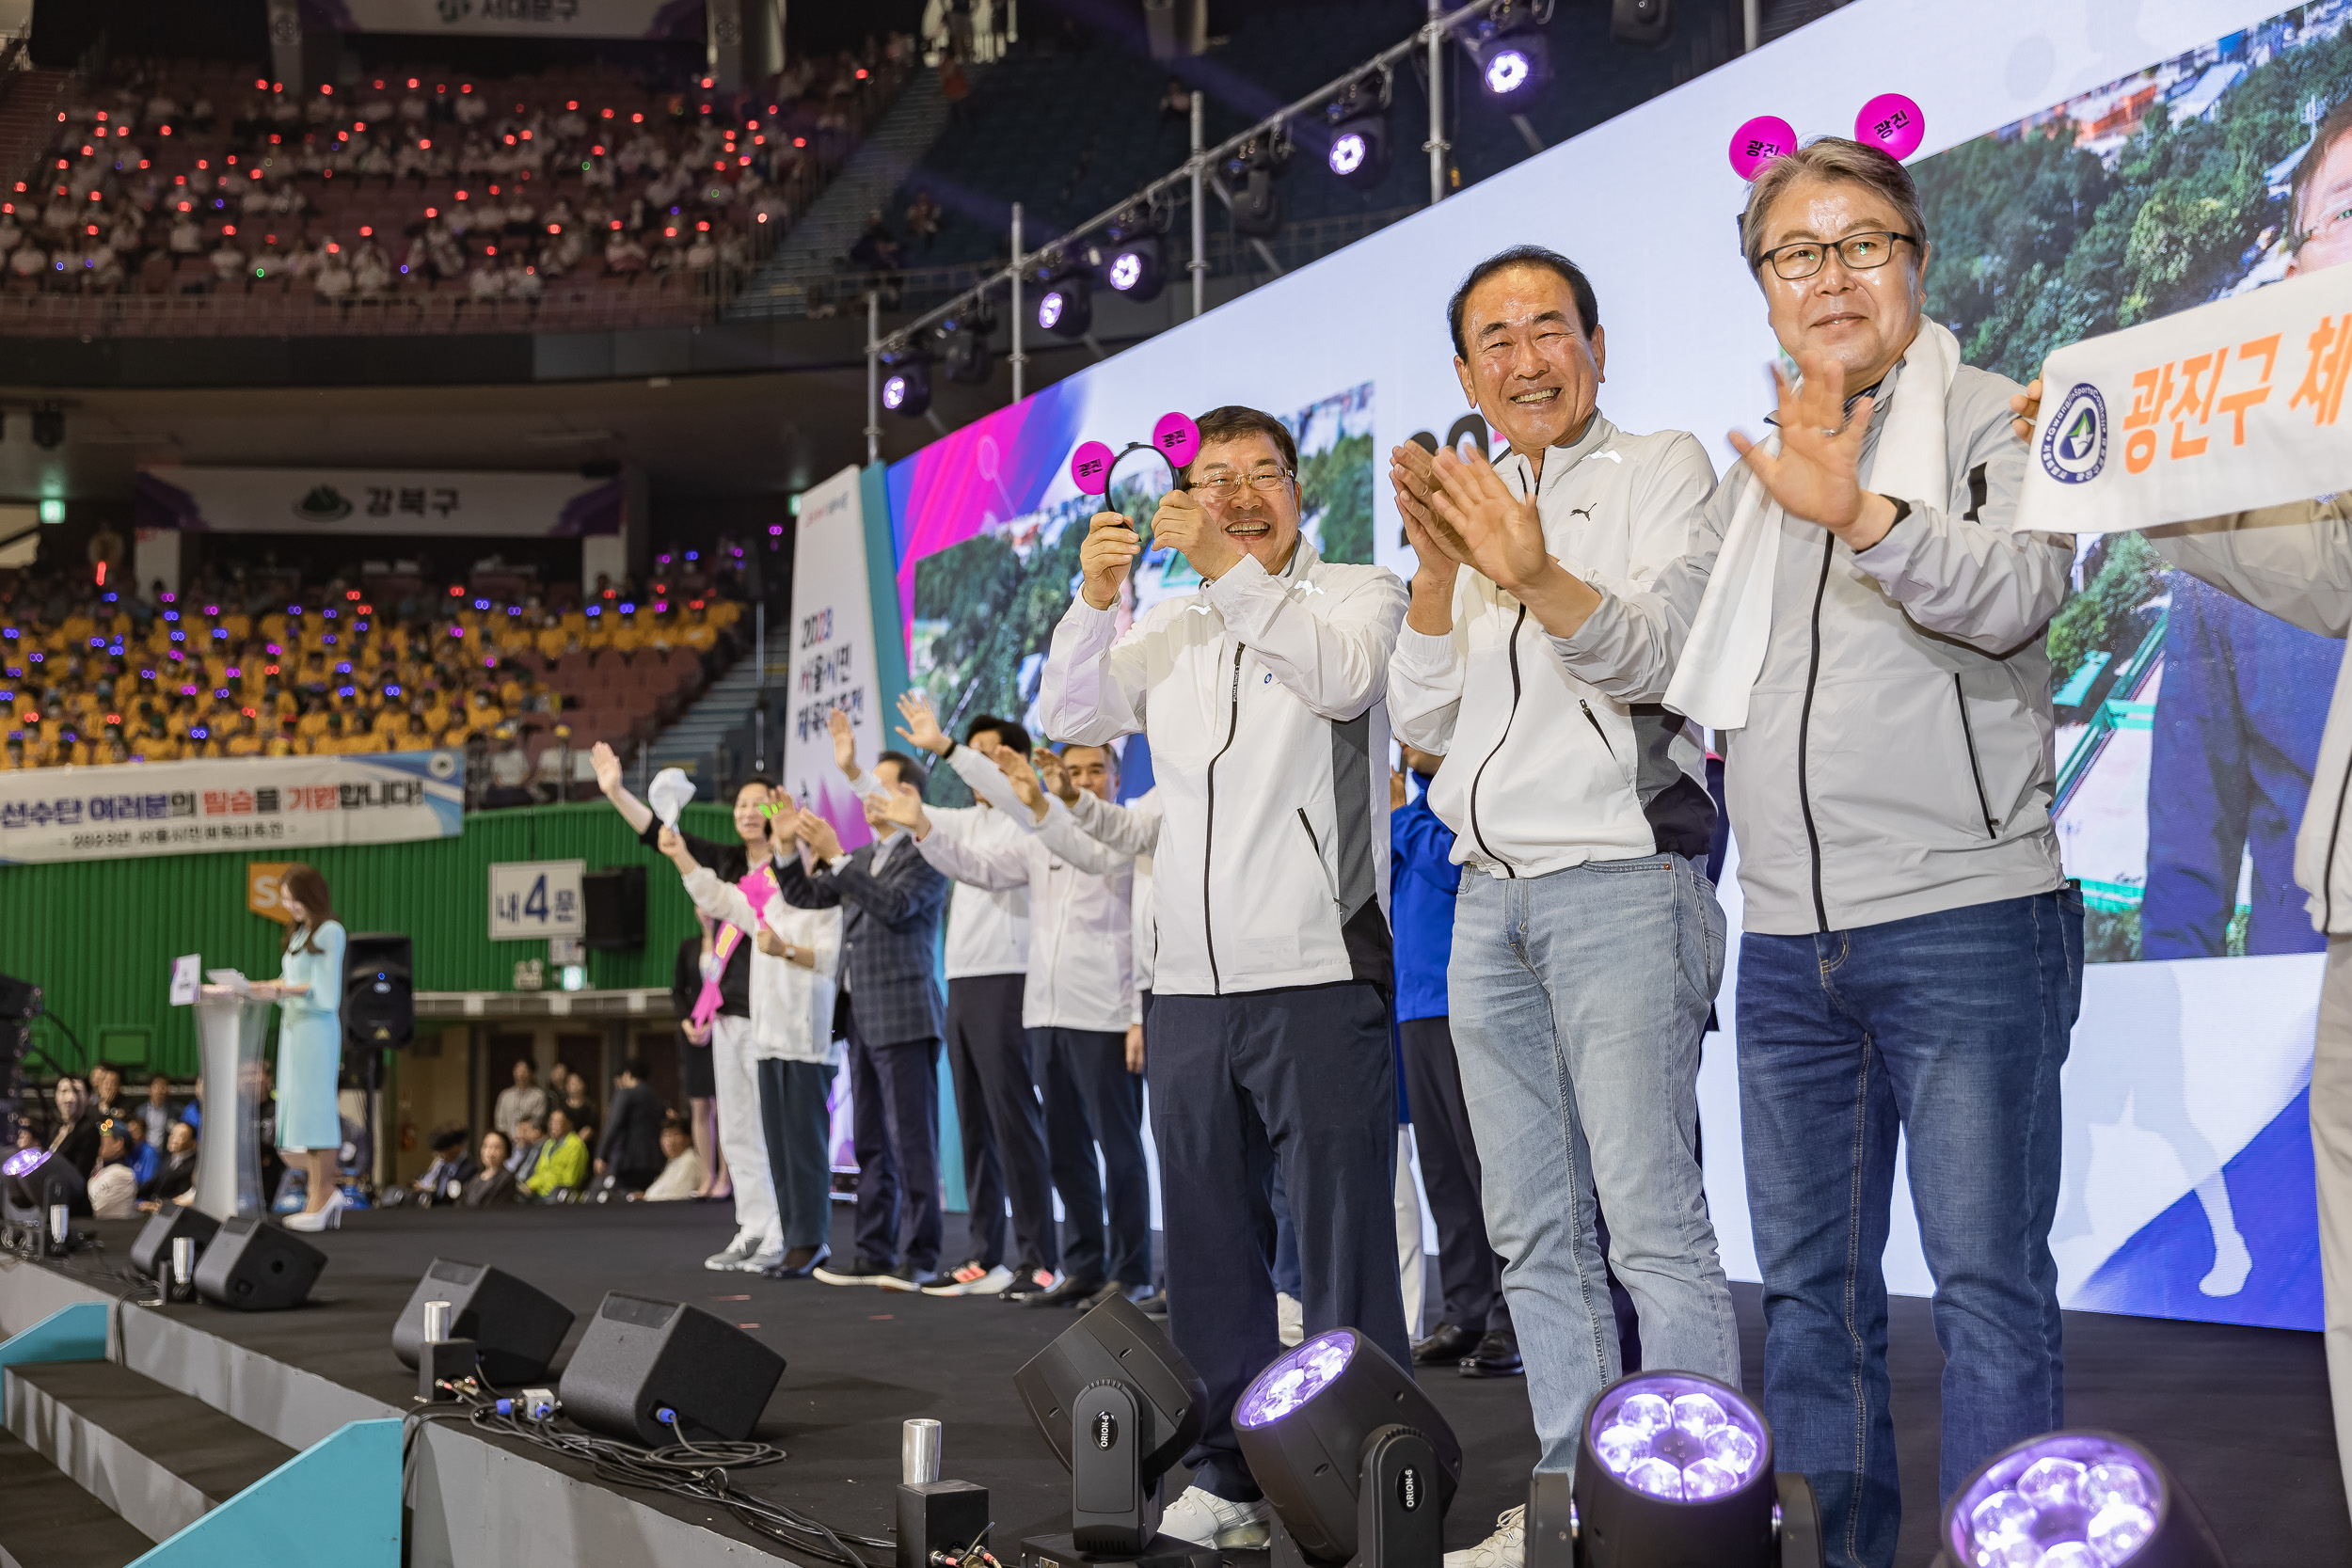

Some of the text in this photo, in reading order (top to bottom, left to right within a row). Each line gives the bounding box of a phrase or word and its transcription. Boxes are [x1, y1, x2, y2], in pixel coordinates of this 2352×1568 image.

[1873, 109, 1911, 140] 광진
[1745, 139, 1781, 159] 광진
[2122, 331, 2284, 475] 광진구
[1160, 429, 1187, 448] 광진
[1076, 458, 1104, 478] 광진
[365, 485, 461, 518] 강북구
[801, 607, 834, 650] 2023
[2, 798, 83, 828] 선수단
[88, 790, 197, 822] 여러분의
[202, 786, 279, 816] 필승을
[1100, 1415, 1109, 1448] ORION-6
[1405, 1469, 1415, 1508] ORION-6
